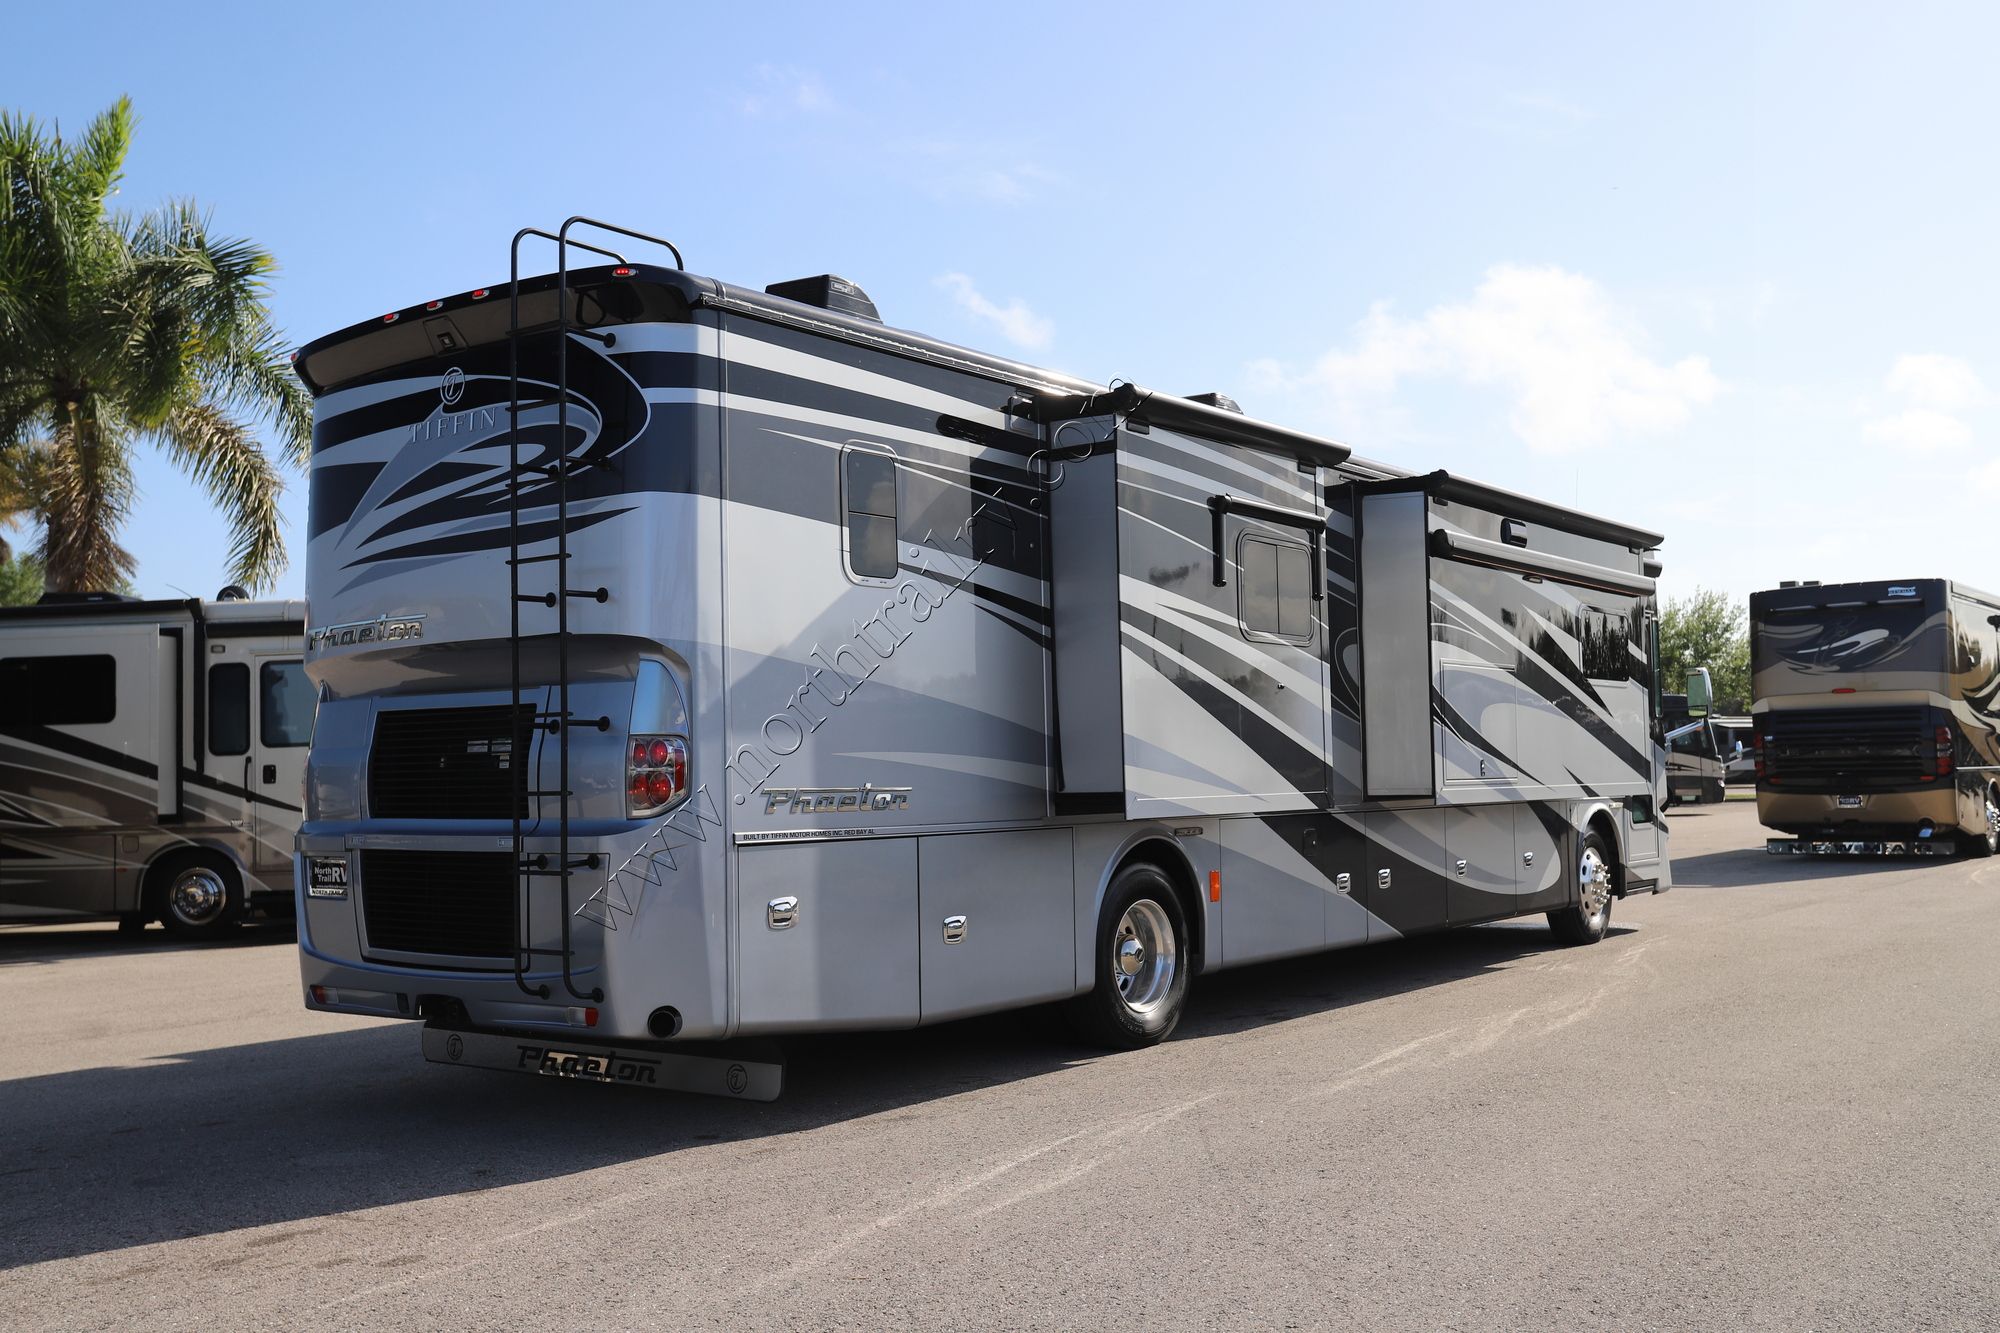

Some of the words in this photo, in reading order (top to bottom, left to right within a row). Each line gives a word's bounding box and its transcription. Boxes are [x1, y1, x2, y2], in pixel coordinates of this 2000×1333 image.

[407, 407, 497, 443] TIFFIN
[760, 782, 913, 815] Phaeton
[332, 867, 348, 883] RV
[517, 1045, 662, 1083] Phaeton
